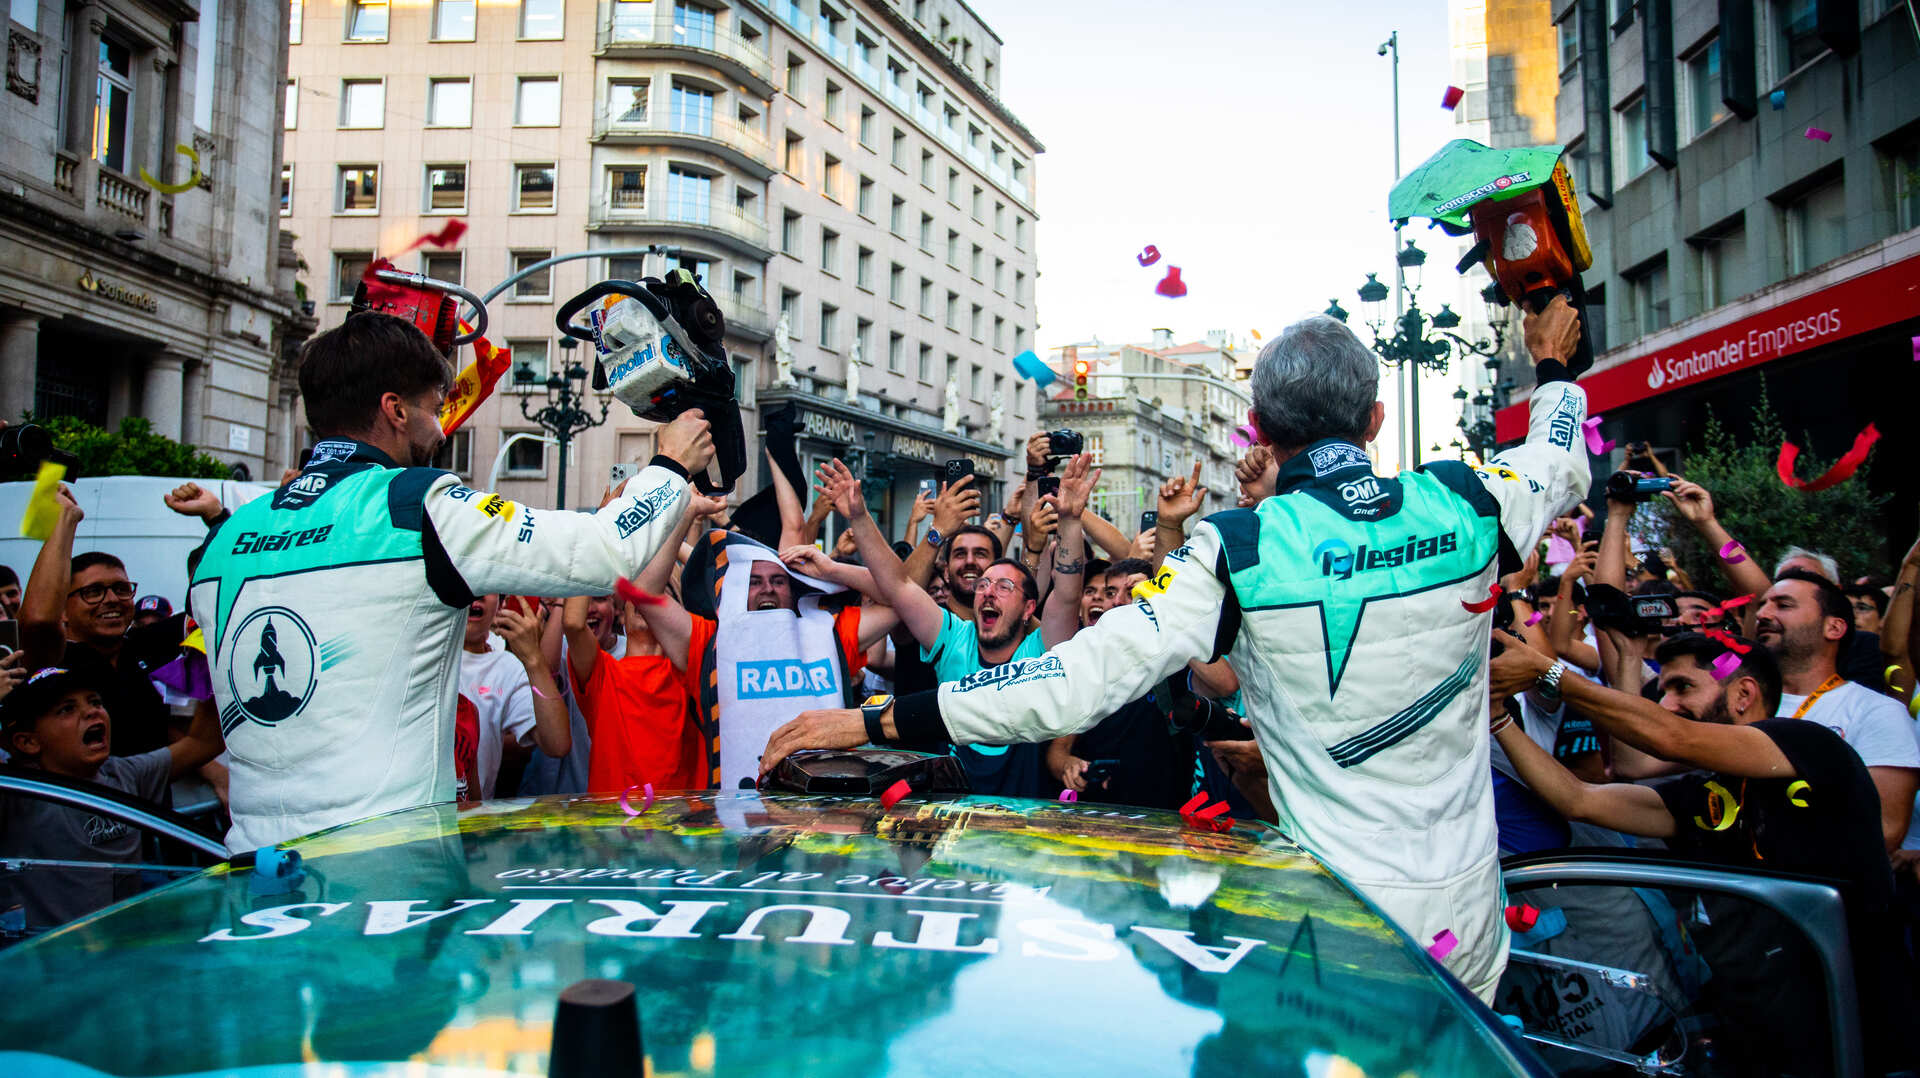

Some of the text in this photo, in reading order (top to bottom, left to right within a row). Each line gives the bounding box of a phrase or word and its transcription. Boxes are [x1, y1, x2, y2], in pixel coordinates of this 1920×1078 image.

[98, 278, 158, 314] Santander
[1665, 308, 1841, 384] Santander Empresas
[802, 411, 857, 443] ABANCA
[892, 434, 937, 461] ABANCA
[965, 453, 999, 475] BANCA
[231, 524, 335, 555] Suárez
[1321, 531, 1458, 582] Iglesias
[197, 899, 1267, 974] ASTURIAS
